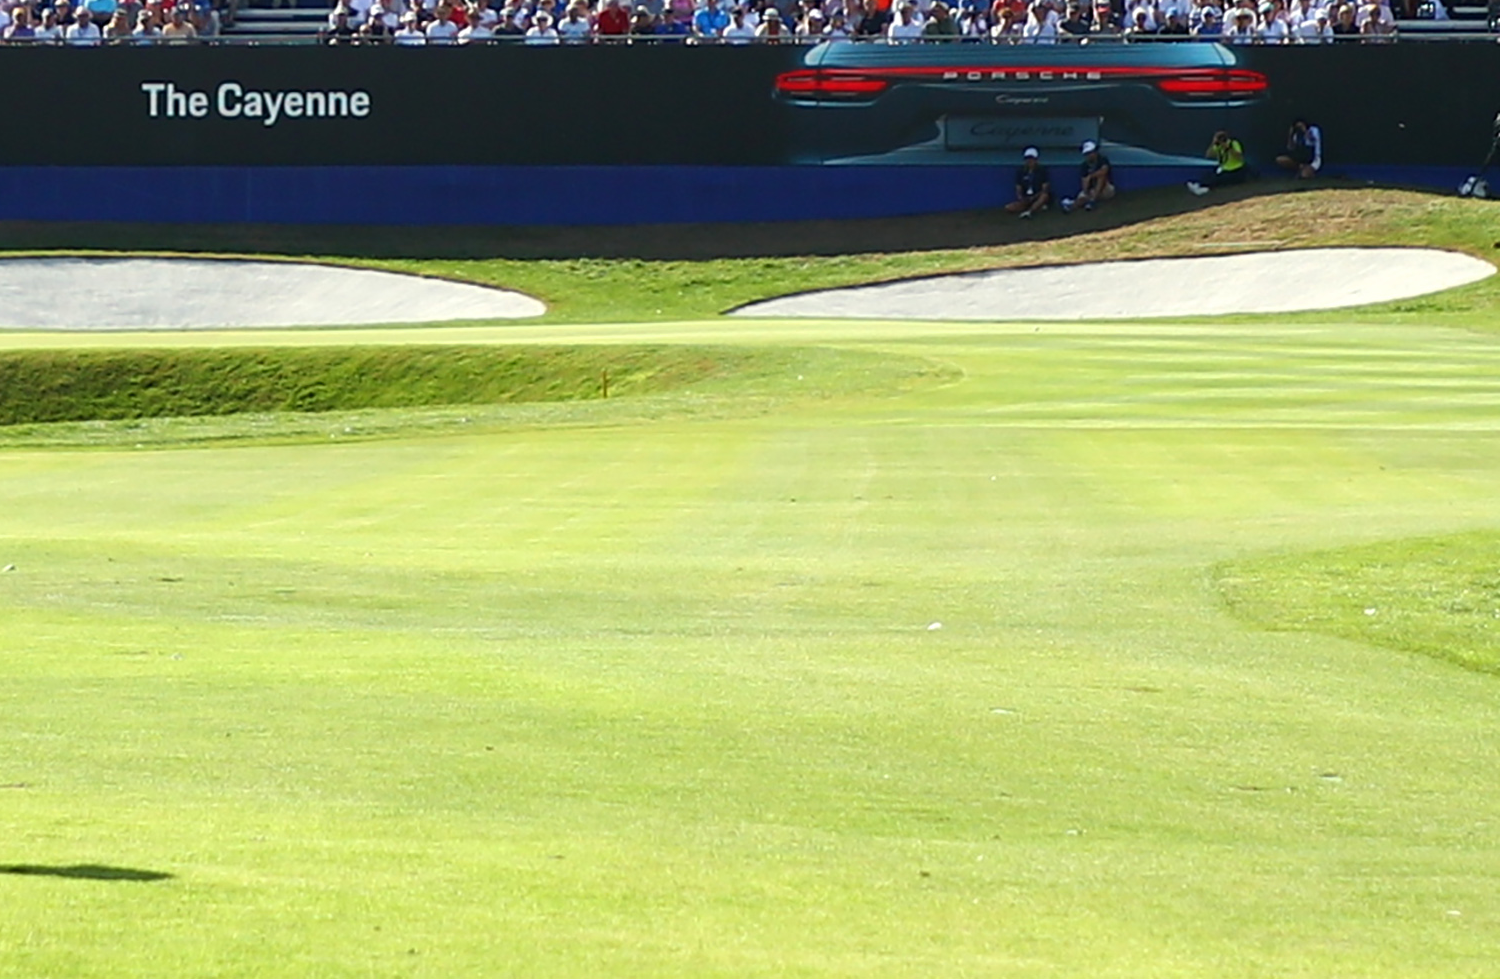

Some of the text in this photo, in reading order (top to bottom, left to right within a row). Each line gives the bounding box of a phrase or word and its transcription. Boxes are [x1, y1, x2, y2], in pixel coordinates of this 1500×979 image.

[942, 71, 1102, 81] PORSCHE
[141, 83, 371, 126] The Cayenne
